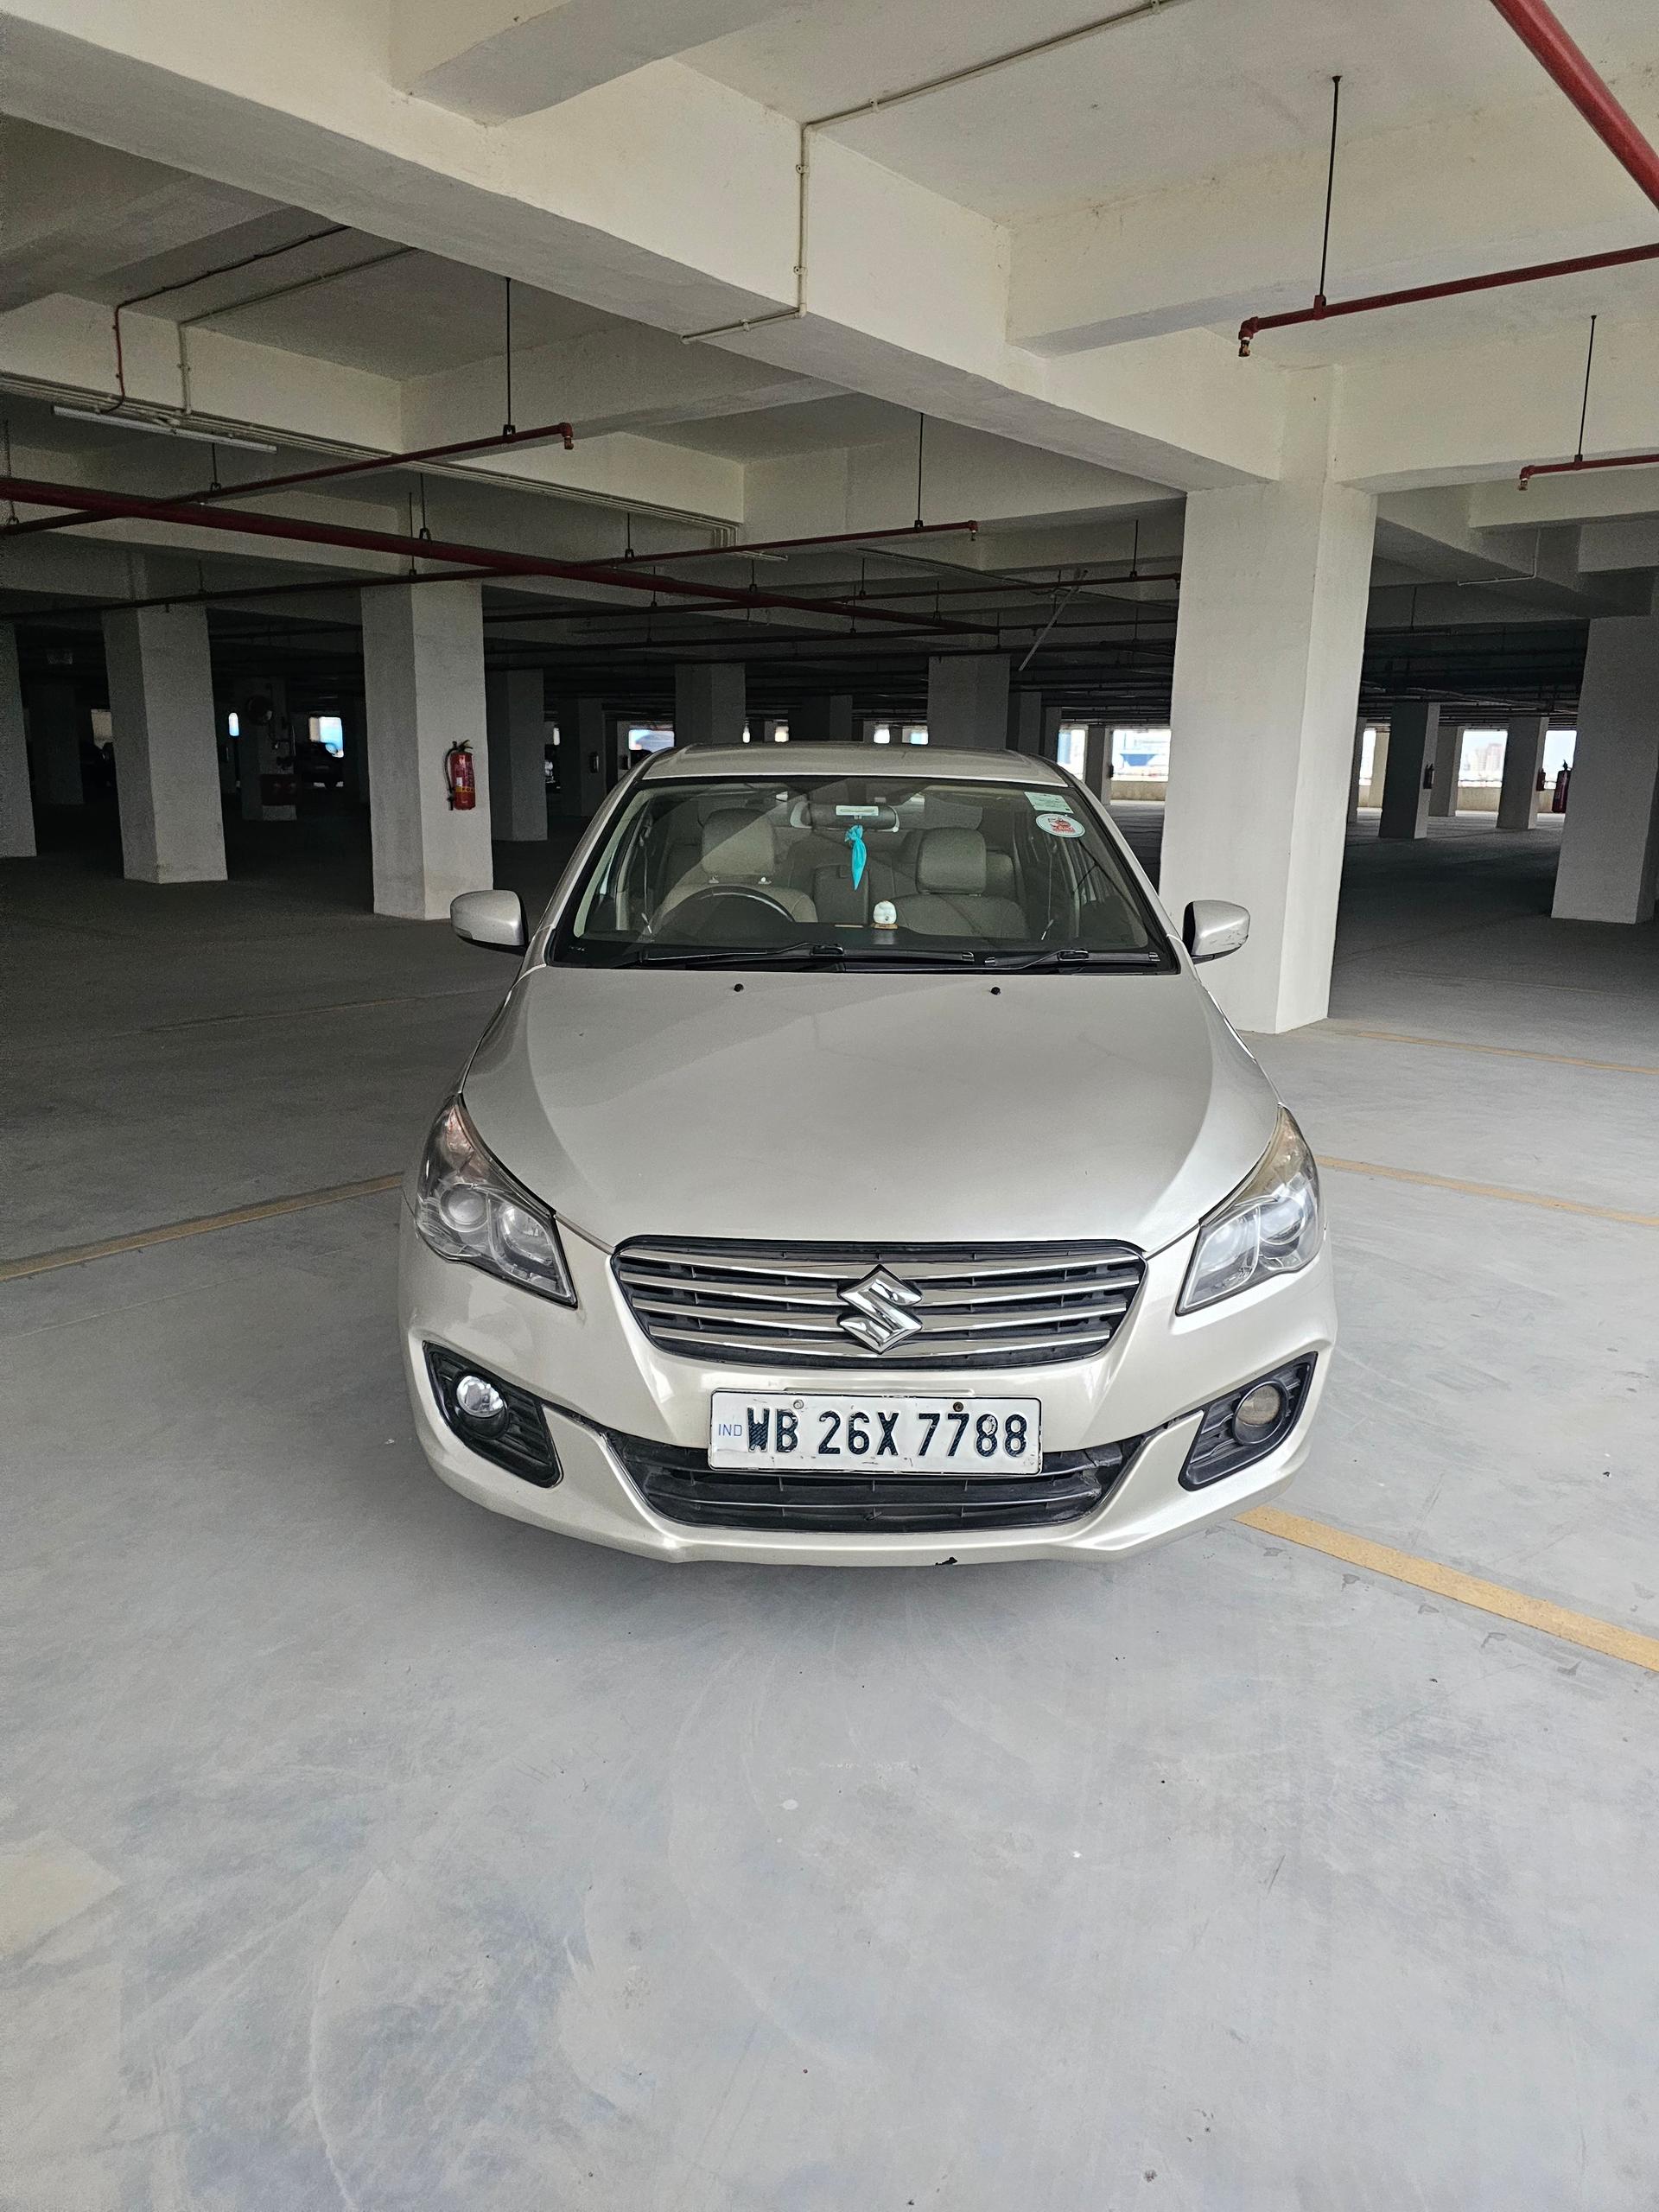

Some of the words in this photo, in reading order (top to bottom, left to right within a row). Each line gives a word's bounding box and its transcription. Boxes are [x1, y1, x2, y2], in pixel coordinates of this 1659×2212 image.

[718, 1423, 743, 1437] IND
[747, 1407, 798, 1453] WB
[817, 1410, 899, 1455] 26X
[918, 1412, 1028, 1458] 7788
